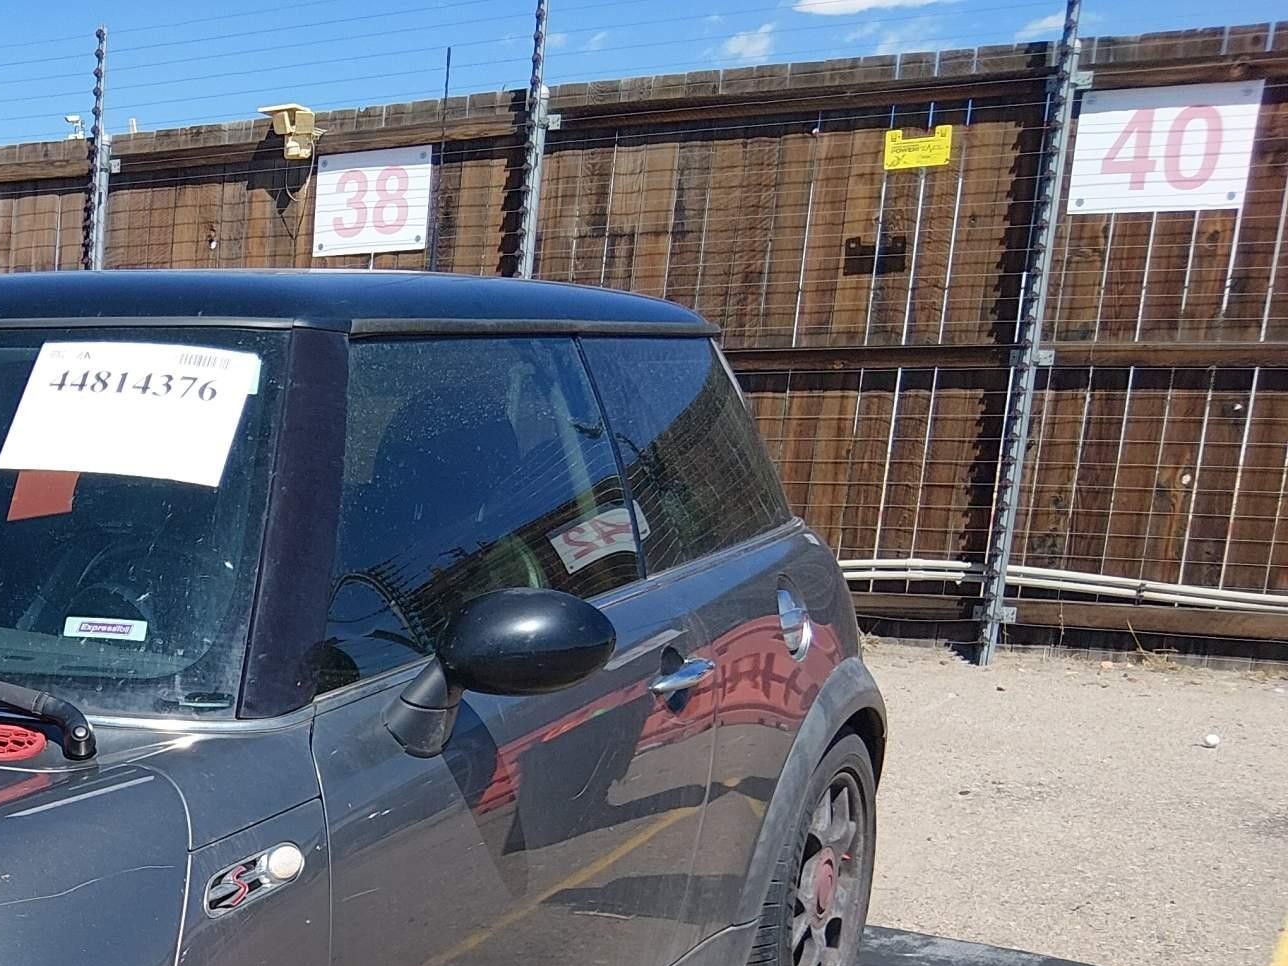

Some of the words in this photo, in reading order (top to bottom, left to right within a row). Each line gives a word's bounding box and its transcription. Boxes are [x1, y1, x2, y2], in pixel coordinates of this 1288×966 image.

[1100, 104, 1224, 192] 40
[331, 164, 410, 238] 38
[48, 370, 218, 401] 44814376
